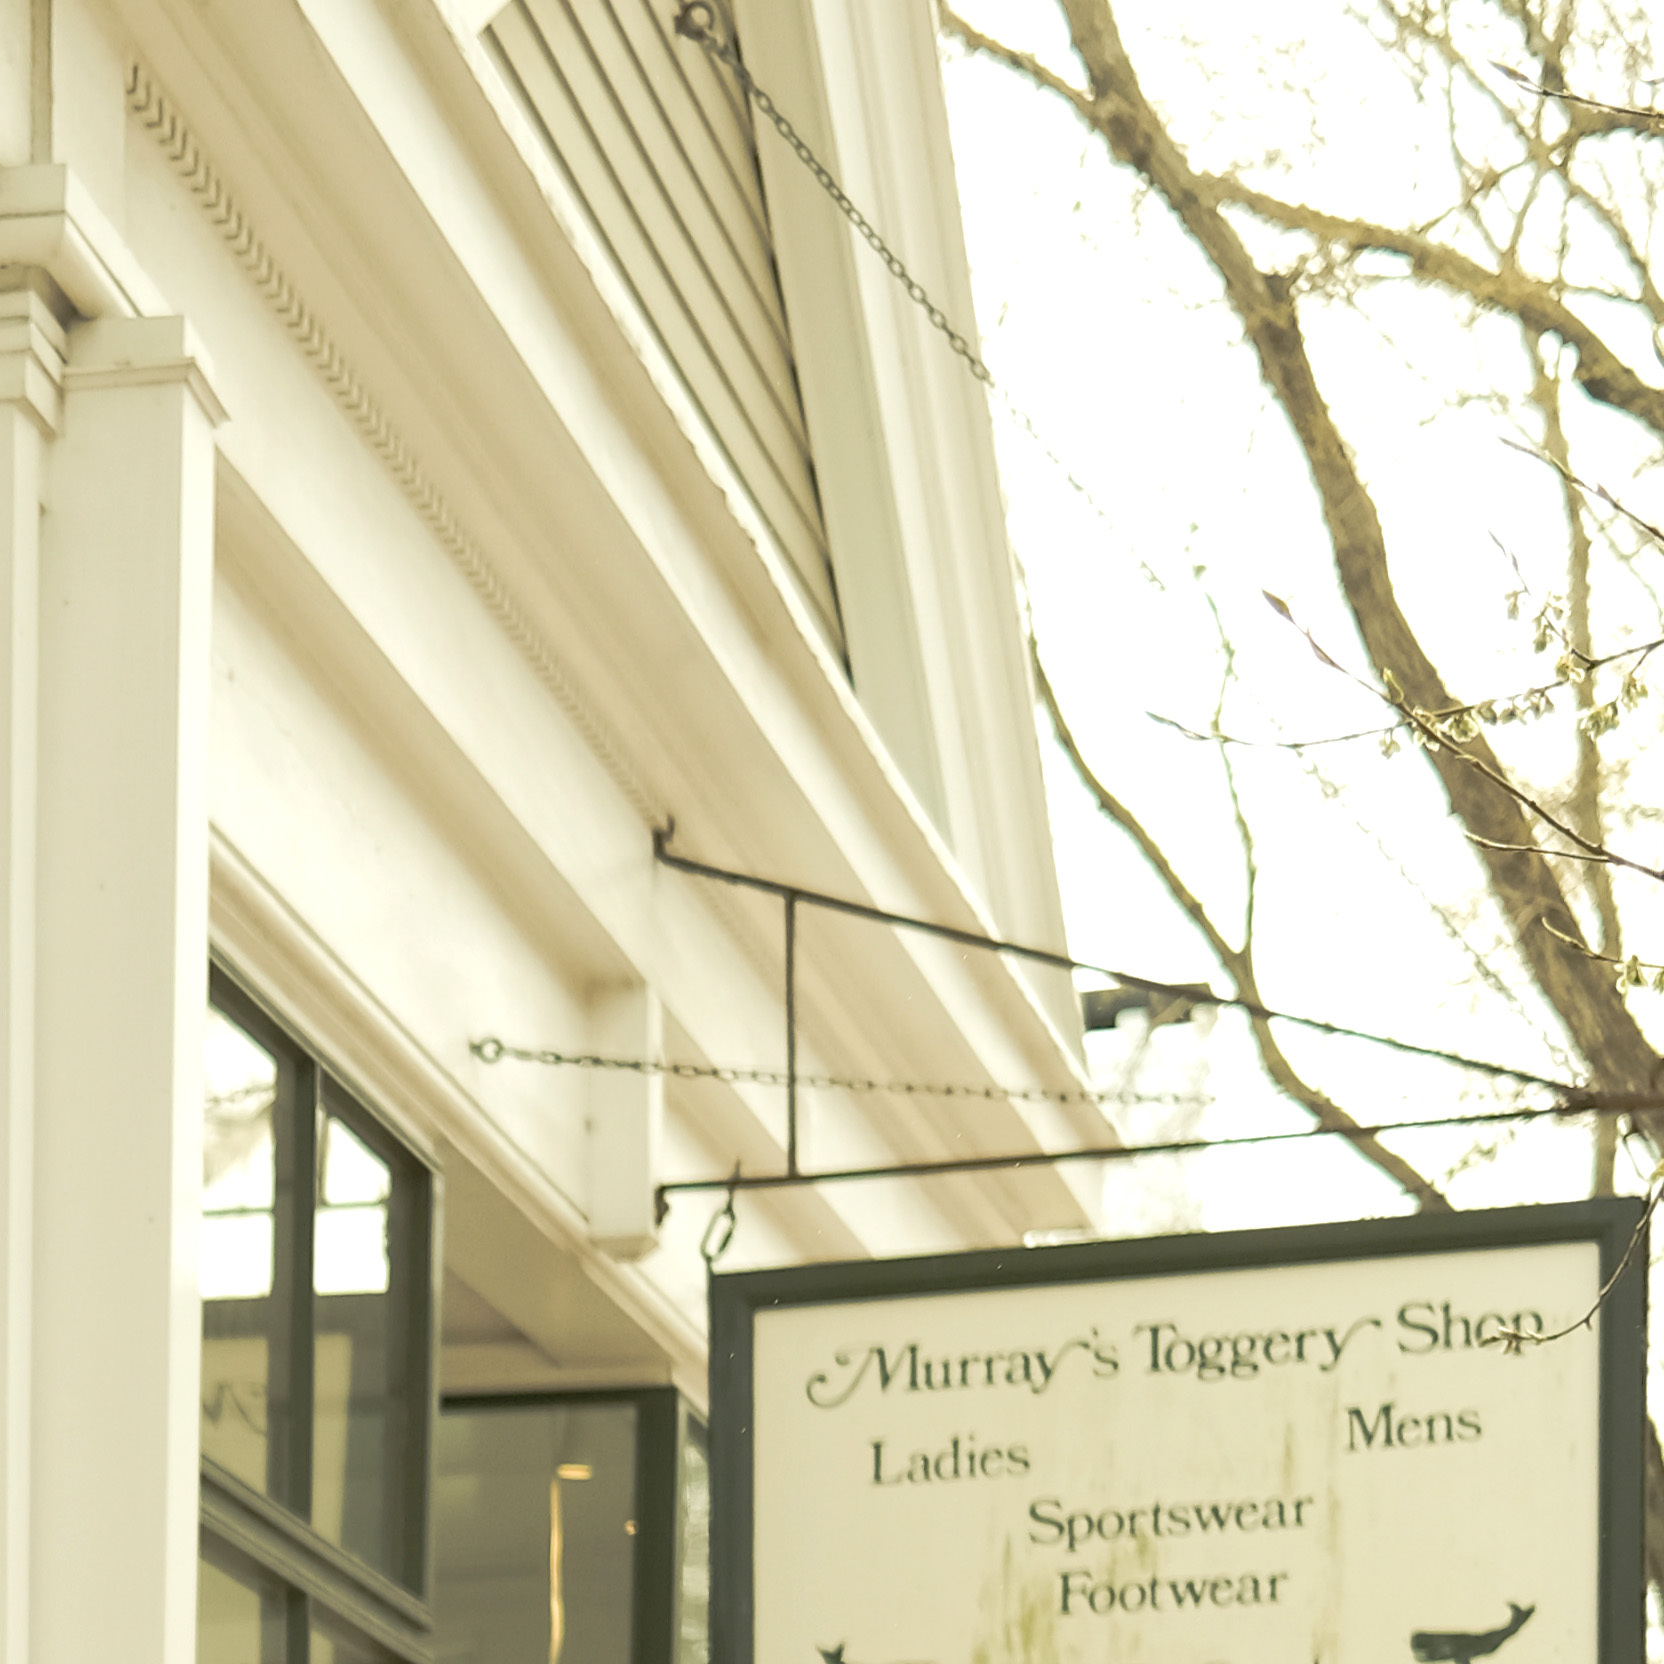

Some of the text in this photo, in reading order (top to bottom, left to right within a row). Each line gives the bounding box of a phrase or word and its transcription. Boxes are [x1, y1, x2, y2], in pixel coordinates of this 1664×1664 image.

[806, 1326, 1118, 1409] Murray's
[1133, 1319, 1381, 1382] Toggery
[1347, 1402, 1482, 1452] Mens
[871, 1433, 1030, 1485] Ladies
[1028, 1496, 1313, 1552] Sportswear
[1058, 1569, 1289, 1616] Footwear
